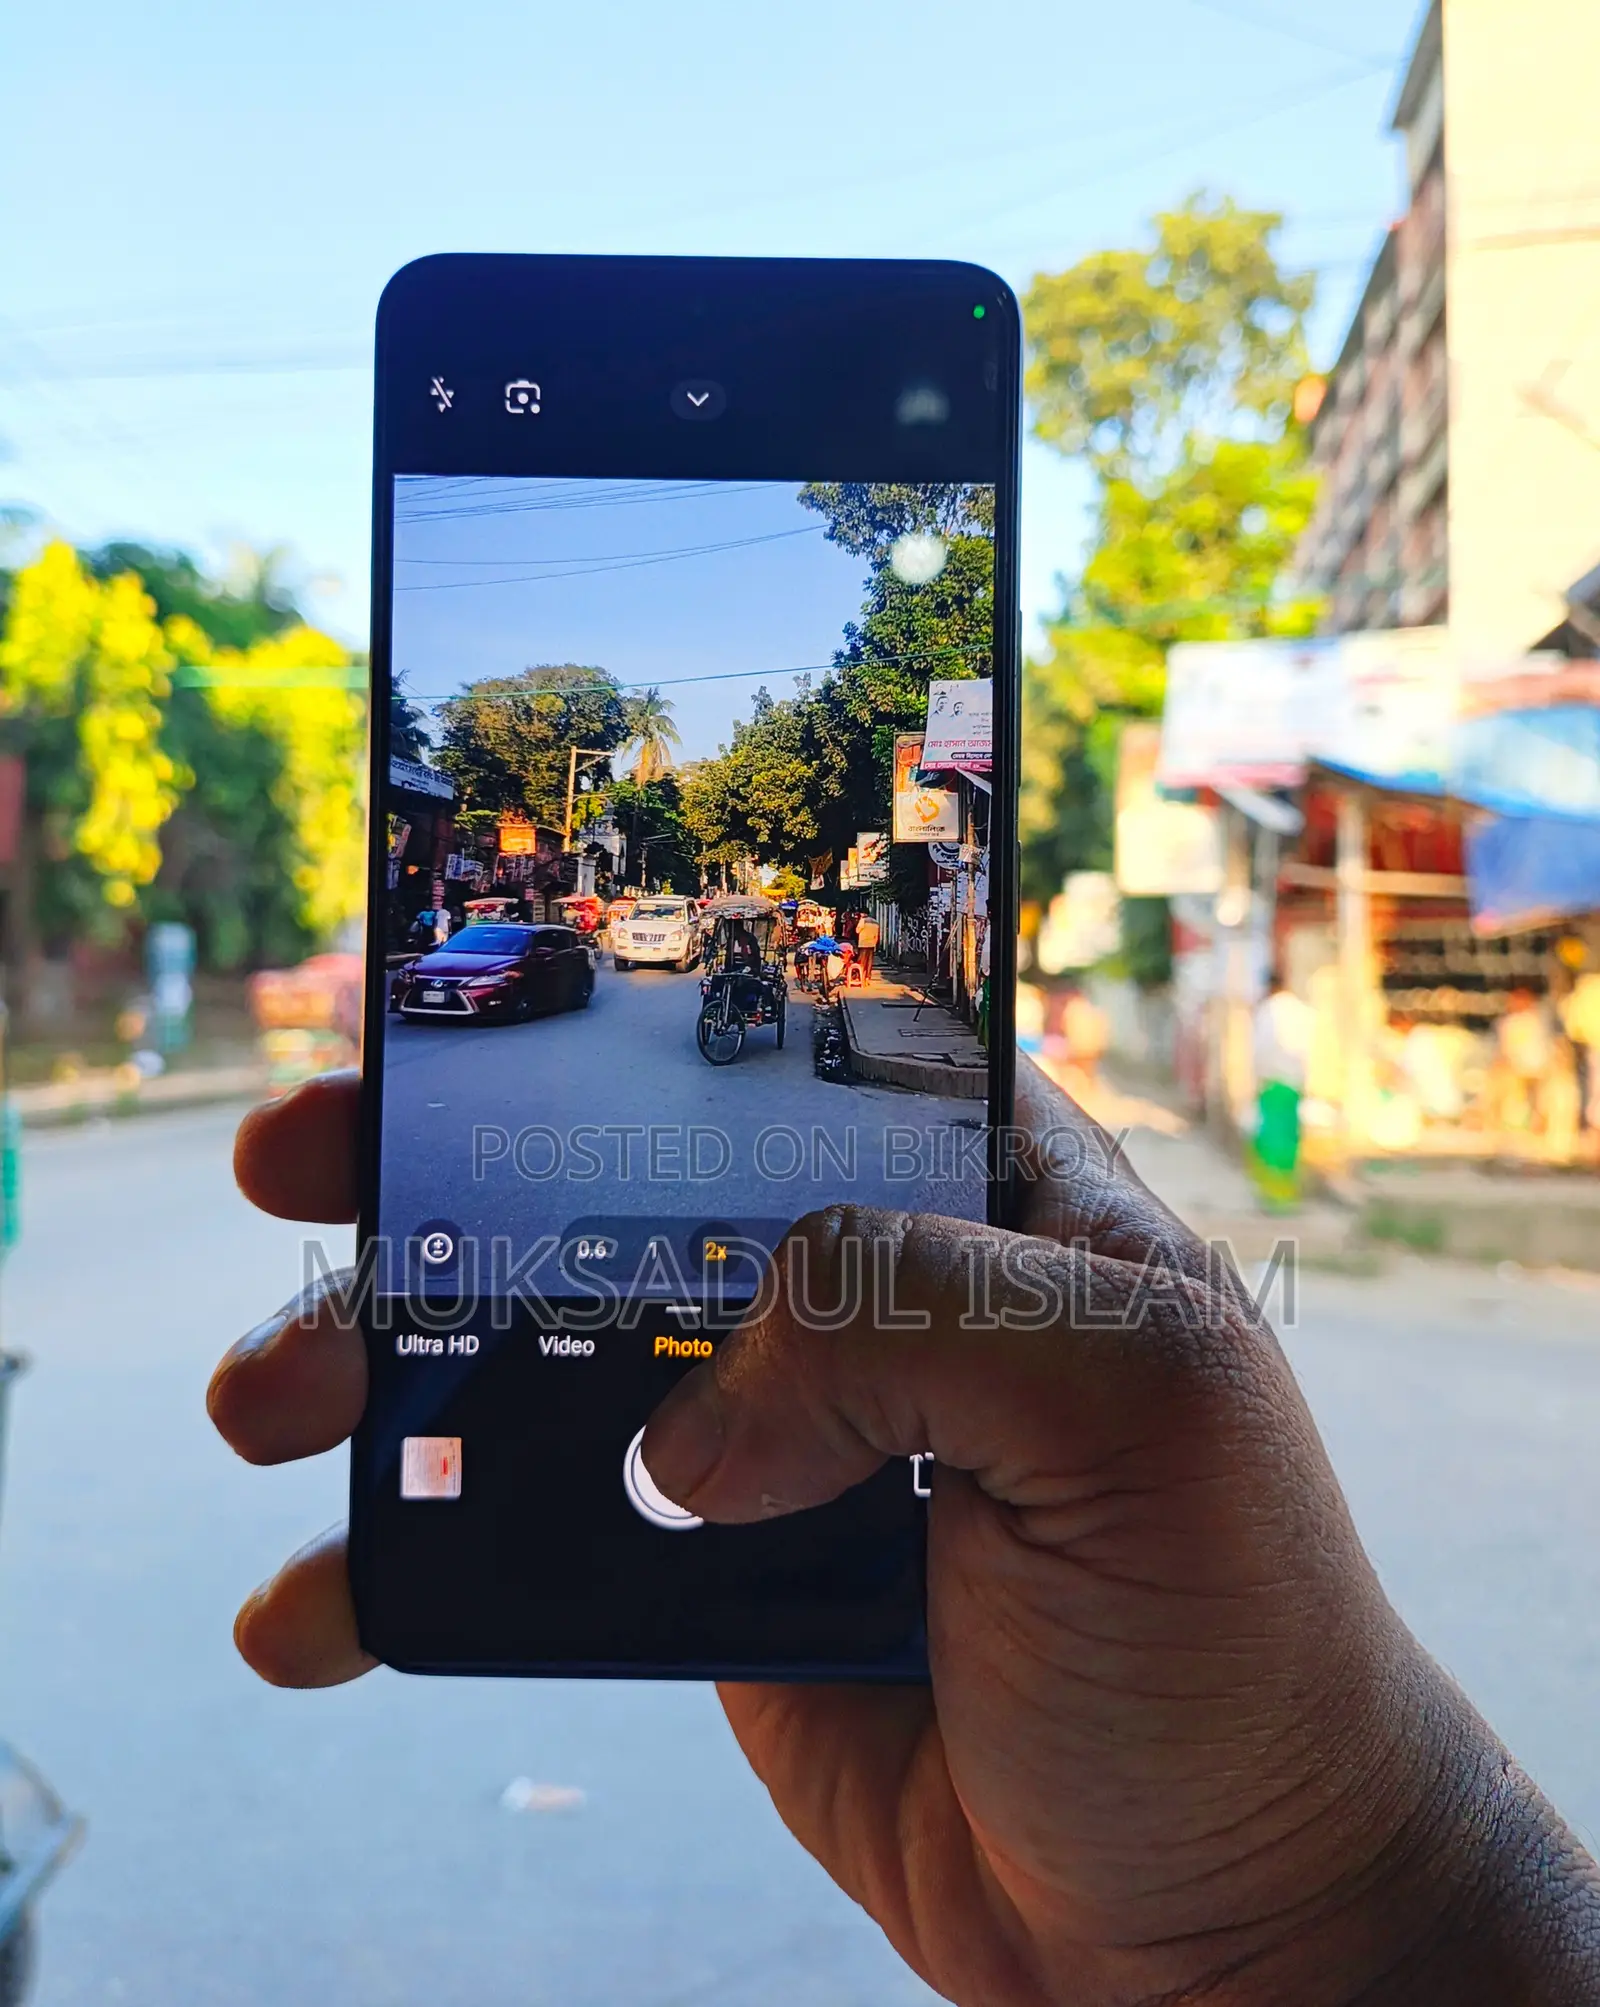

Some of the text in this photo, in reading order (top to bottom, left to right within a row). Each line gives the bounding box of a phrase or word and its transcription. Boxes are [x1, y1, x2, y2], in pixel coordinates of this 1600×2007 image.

[577, 1240, 607, 1260] 0.6
[705, 1241, 727, 1261] 2x
[396, 1334, 480, 1356] Ultra HD
[538, 1335, 595, 1357] Video
[654, 1336, 713, 1358] Photo
